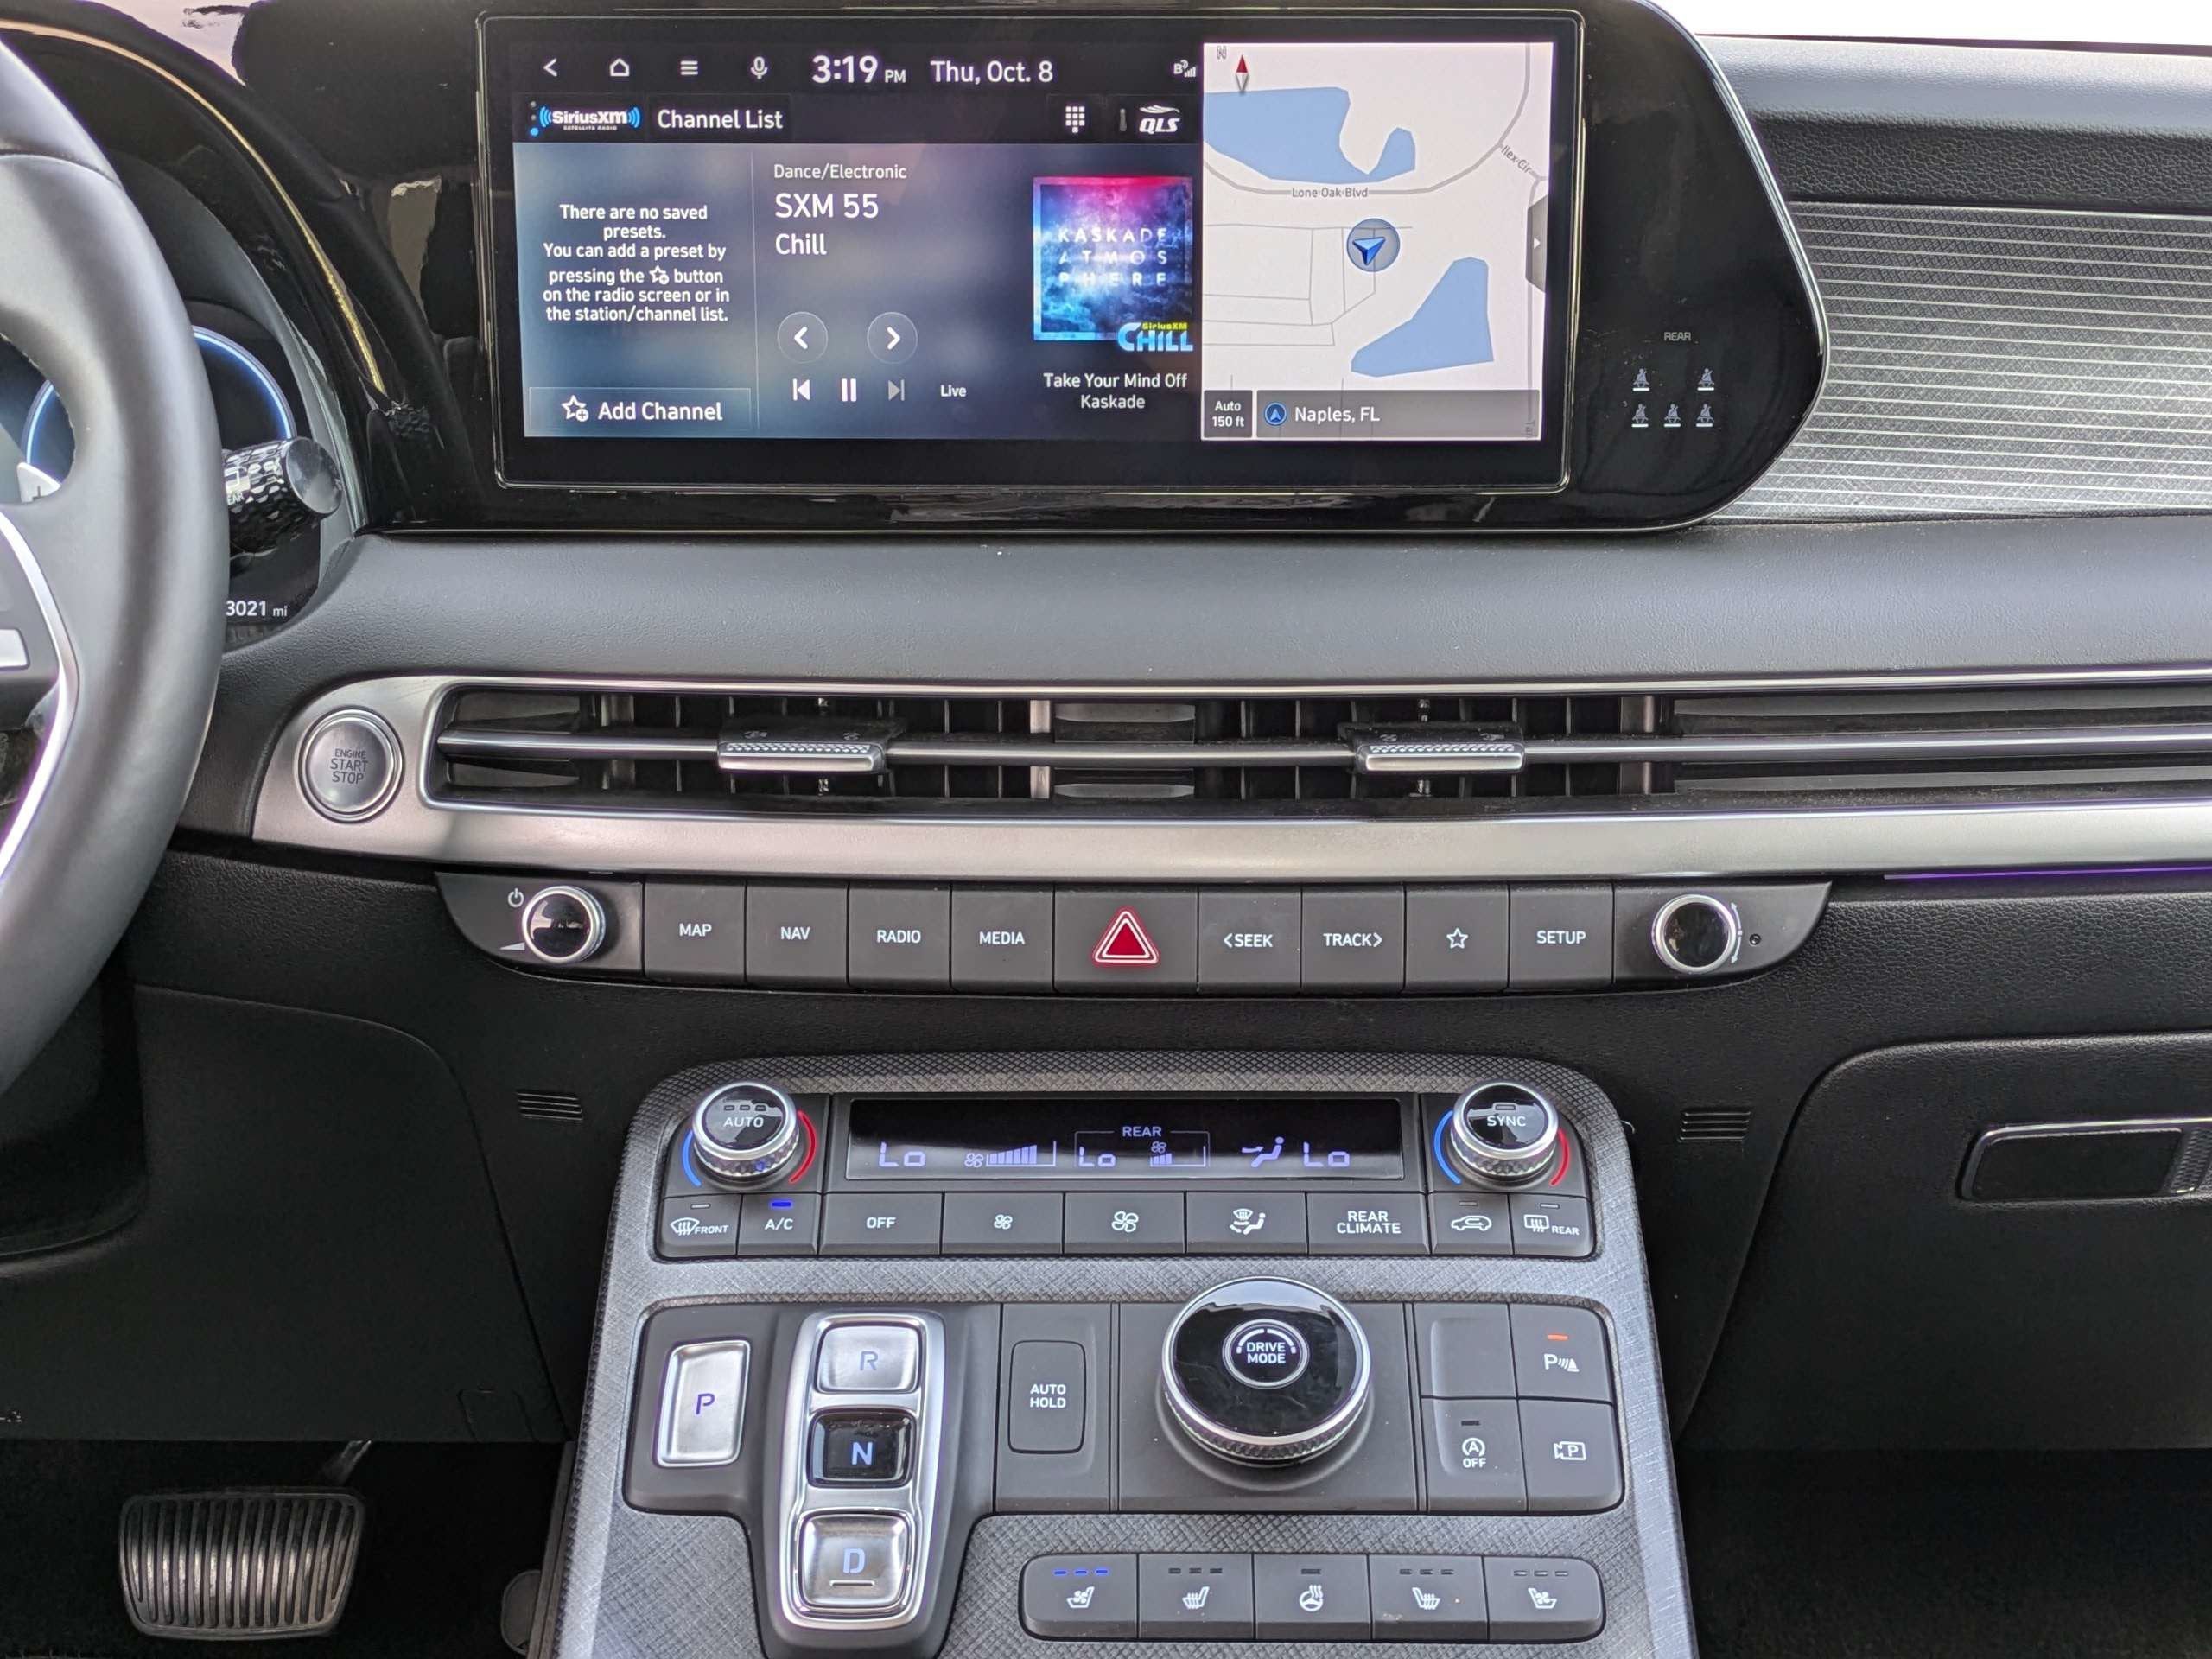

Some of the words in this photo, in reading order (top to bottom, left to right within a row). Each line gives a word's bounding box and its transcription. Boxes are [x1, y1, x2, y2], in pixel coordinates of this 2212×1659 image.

[812, 55, 878, 84] 3:19
[885, 69, 906, 83] PM
[931, 60, 981, 85] Thu,
[987, 60, 1031, 83] Oct.
[1039, 60, 1053, 83] 8
[658, 109, 741, 129] Channel
[746, 110, 783, 129] List
[774, 163, 907, 181] Dance/Electronic
[1292, 187, 1317, 198] Lone
[1320, 187, 1341, 198] Oak
[1345, 186, 1369, 198] Blvd
[560, 204, 605, 220] There
[610, 208, 635, 220] are
[640, 208, 658, 219] no
[663, 206, 708, 219] saved
[775, 193, 834, 218] SXM
[843, 194, 879, 218] 55
[603, 224, 666, 241] presets.
[1058, 228, 1167, 243] KASKADE
[543, 242, 571, 257] You
[576, 246, 603, 257] can
[608, 243, 636, 258] add
[641, 247, 649, 258] a
[654, 243, 703, 261] preset
[708, 243, 726, 261] by
[775, 233, 827, 256] Chill
[549, 268, 615, 286] pressing
[620, 269, 645, 283] the
[674, 269, 723, 283] button
[543, 289, 562, 302] on
[566, 287, 590, 302] the
[594, 287, 634, 302] radio
[639, 289, 690, 302] screen
[695, 289, 711, 302] or
[715, 288, 729, 302] in
[546, 306, 570, 321] the
[575, 305, 696, 322] station/channel
[700, 306, 728, 321] list.
[1117, 322, 1194, 352] CHILL
[1664, 332, 1691, 340] REAR
[1043, 372, 1081, 388] Take
[1084, 372, 1120, 388] Your
[1124, 373, 1160, 388] Mind
[1165, 373, 1188, 388] Off
[940, 385, 967, 397] Live
[1080, 394, 1146, 409] Kaskade
[1215, 401, 1242, 412] Auto
[598, 402, 636, 419] Add
[641, 402, 722, 420] Channel
[1294, 407, 1355, 425] Naples,
[1360, 408, 1381, 422] FL
[1212, 416, 1232, 428] 150
[1235, 416, 1245, 428] ft
[226, 601, 266, 617] 3021
[273, 606, 288, 617] mi
[334, 748, 367, 760] ENGINE
[330, 758, 368, 772] START
[332, 771, 365, 785] STOP
[678, 923, 712, 937] MAP
[780, 926, 810, 940] NAV
[876, 930, 922, 944] RADIO
[978, 931, 1026, 945] MEDIA
[1536, 931, 1586, 946] SETUP
[724, 1116, 764, 1128] AUTO
[1486, 1116, 1526, 1128] SYNC
[1122, 1126, 1162, 1137] REAR
[866, 1217, 896, 1230] OFF
[1347, 1211, 1389, 1223] REAR
[694, 1224, 729, 1235] FRONT
[765, 1218, 793, 1231] A/C
[1337, 1223, 1401, 1235] CLIMATE
[1551, 1226, 1580, 1236] REAR
[1246, 1342, 1286, 1353] DRIVE
[859, 1351, 878, 1370] R
[1247, 1353, 1286, 1364] MODE
[1030, 1383, 1067, 1395] AUTO
[695, 1393, 715, 1414] P
[1029, 1395, 1067, 1408] HOLD
[851, 1441, 873, 1465] N
[1463, 1458, 1486, 1468] OFF
[842, 1548, 865, 1573] D
